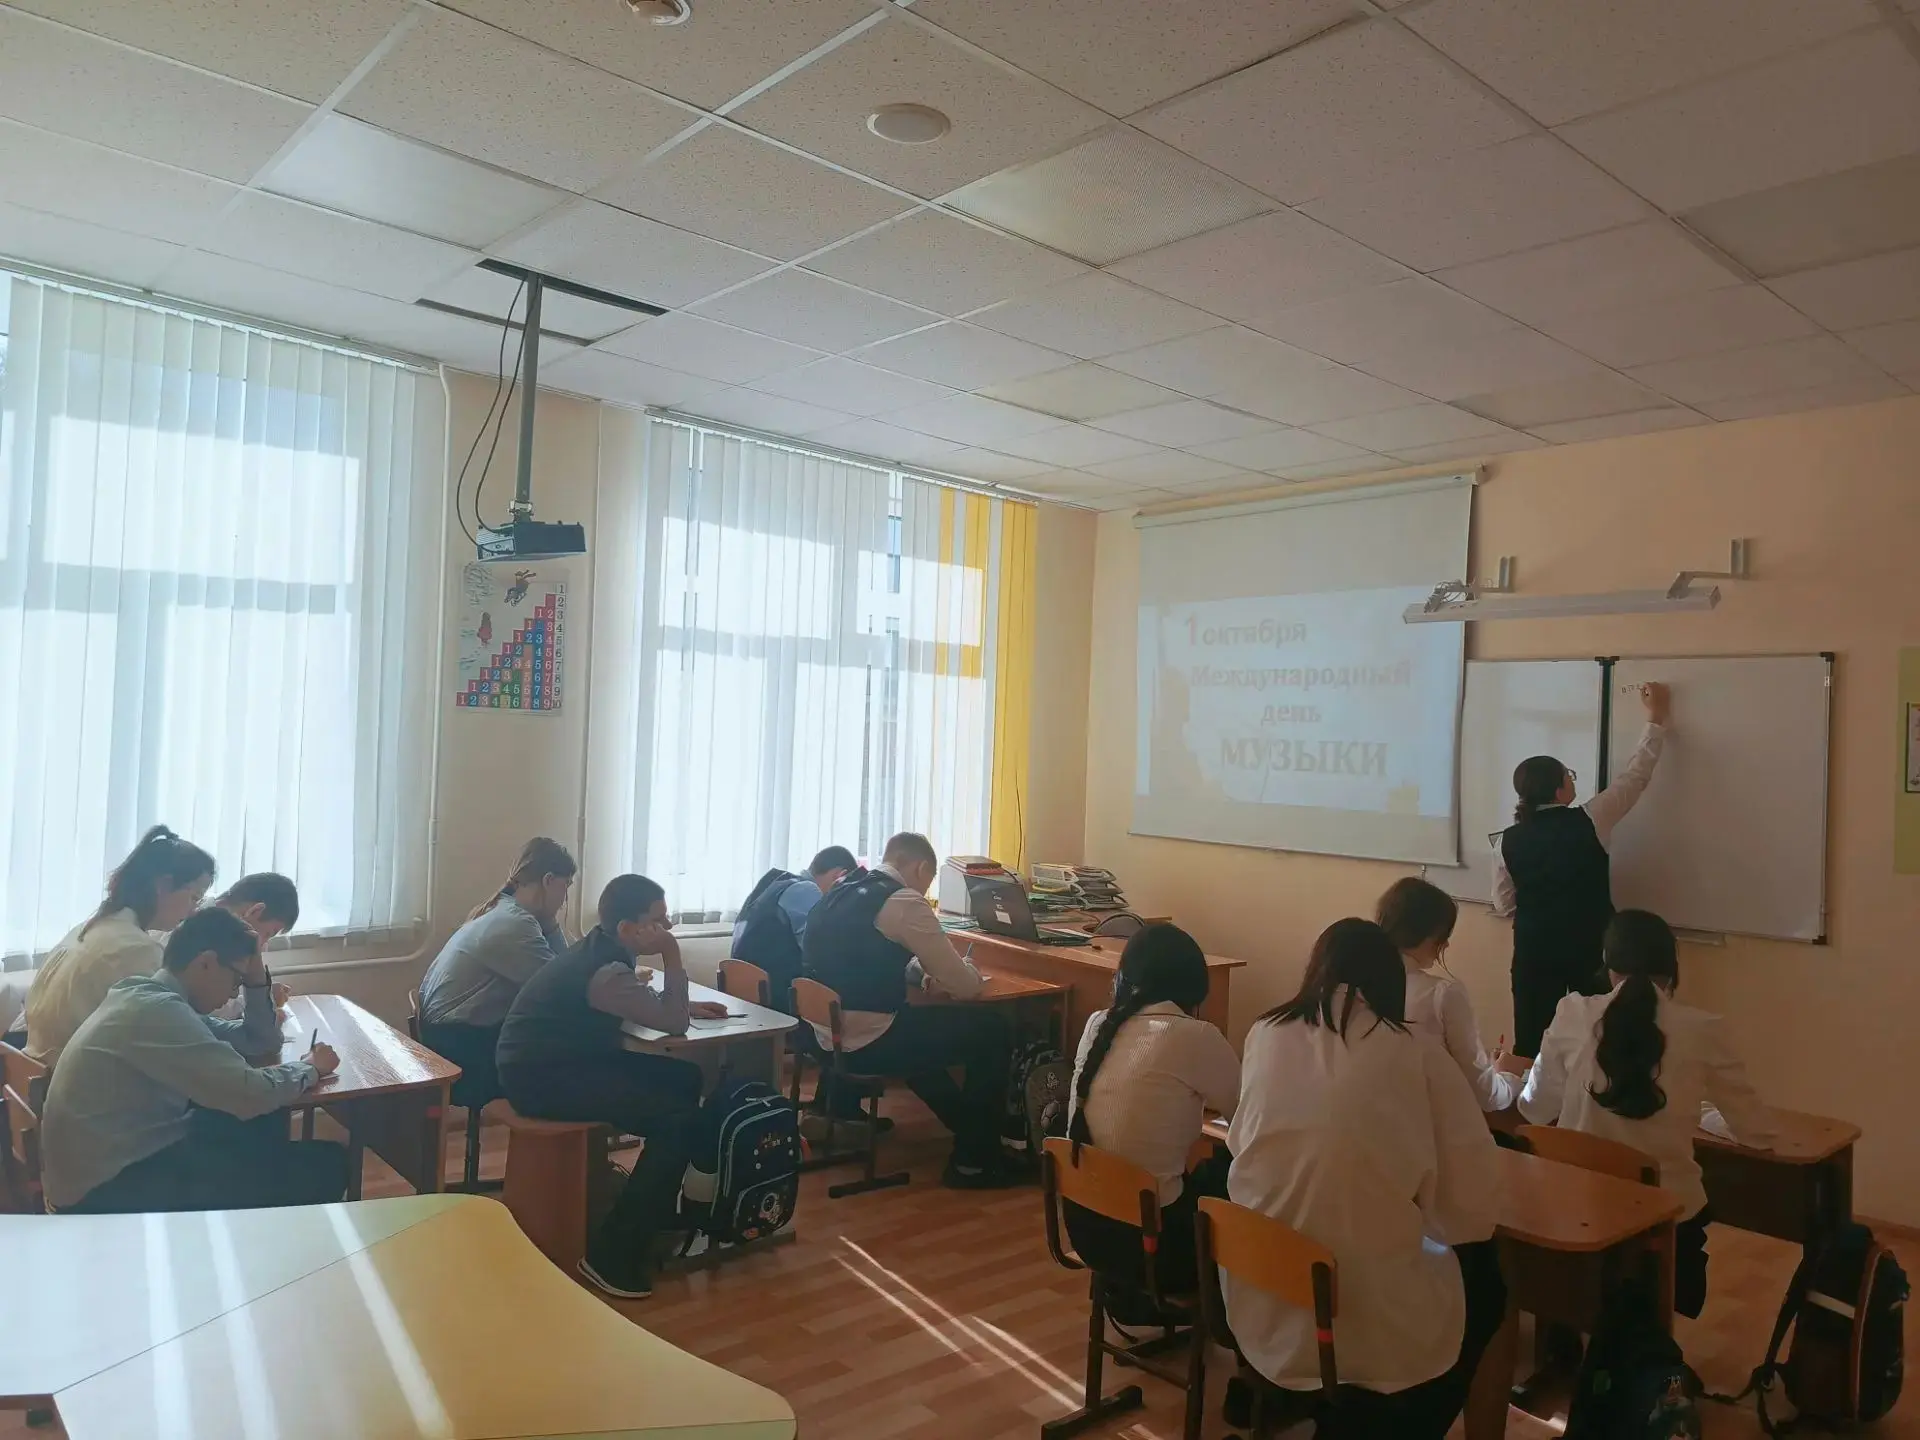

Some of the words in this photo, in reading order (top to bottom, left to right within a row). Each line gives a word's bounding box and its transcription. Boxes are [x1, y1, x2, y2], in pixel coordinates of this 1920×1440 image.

[1202, 618, 1307, 648] октября
[1190, 660, 1412, 691] Международный
[1260, 703, 1322, 726] день
[1220, 737, 1389, 777] МУЗЫКИ
